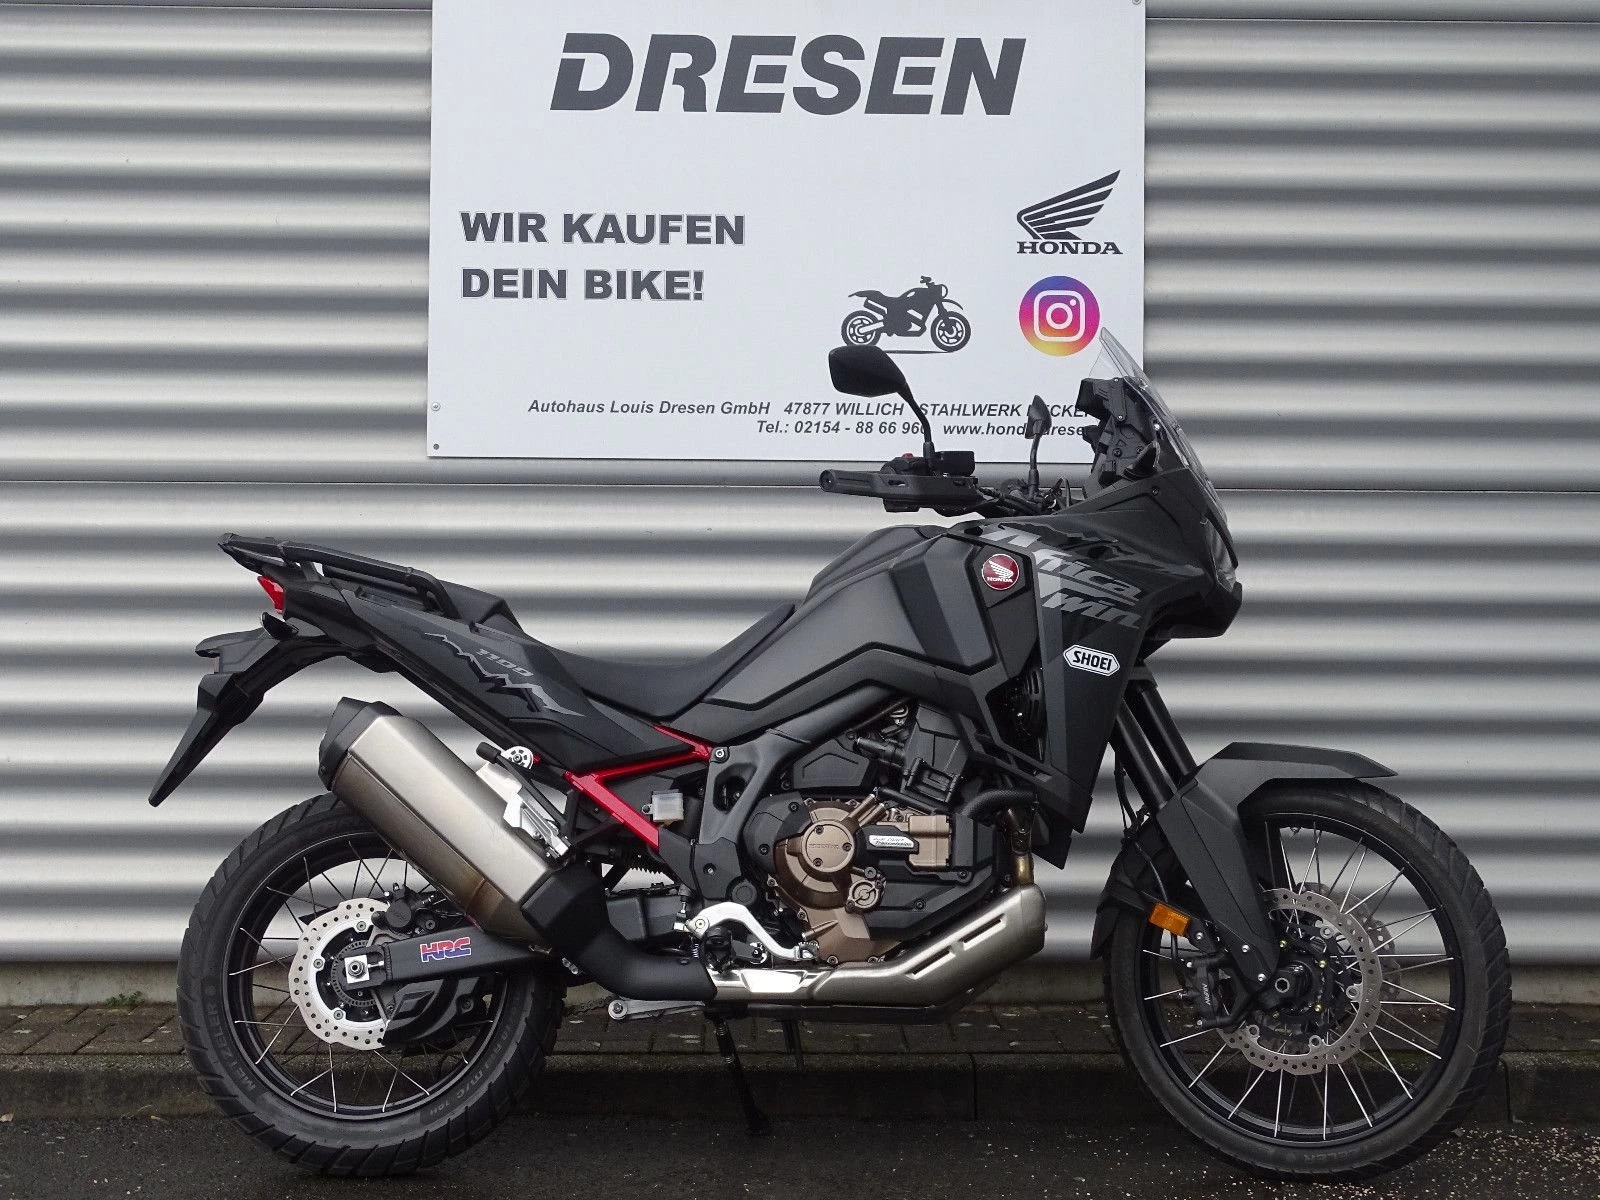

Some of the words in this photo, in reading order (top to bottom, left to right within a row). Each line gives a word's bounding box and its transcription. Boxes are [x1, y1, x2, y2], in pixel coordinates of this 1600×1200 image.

[549, 33, 1026, 115] DRESEN
[461, 213, 547, 243] WIR
[564, 213, 745, 246] KAUFEN
[1017, 241, 1123, 255] HONDA
[462, 269, 566, 299] DEIN
[584, 270, 704, 302] BIKE!
[528, 400, 606, 414] Autohaus
[609, 401, 653, 414] Louis
[659, 401, 715, 414] Dresen
[720, 402, 770, 415] GmbH
[784, 402, 831, 415] 47877
[835, 403, 905, 416] WILLICH
[920, 403, 1022, 417] STAHLWERK
[757, 420, 790, 434] Tel.:
[794, 421, 840, 434] 02154
[856, 421, 874, 434] 88
[879, 422, 897, 434] 66
[476, 648, 534, 676] 1100
[1072, 650, 1113, 672] SHOEI
[420, 937, 472, 963] HRC
